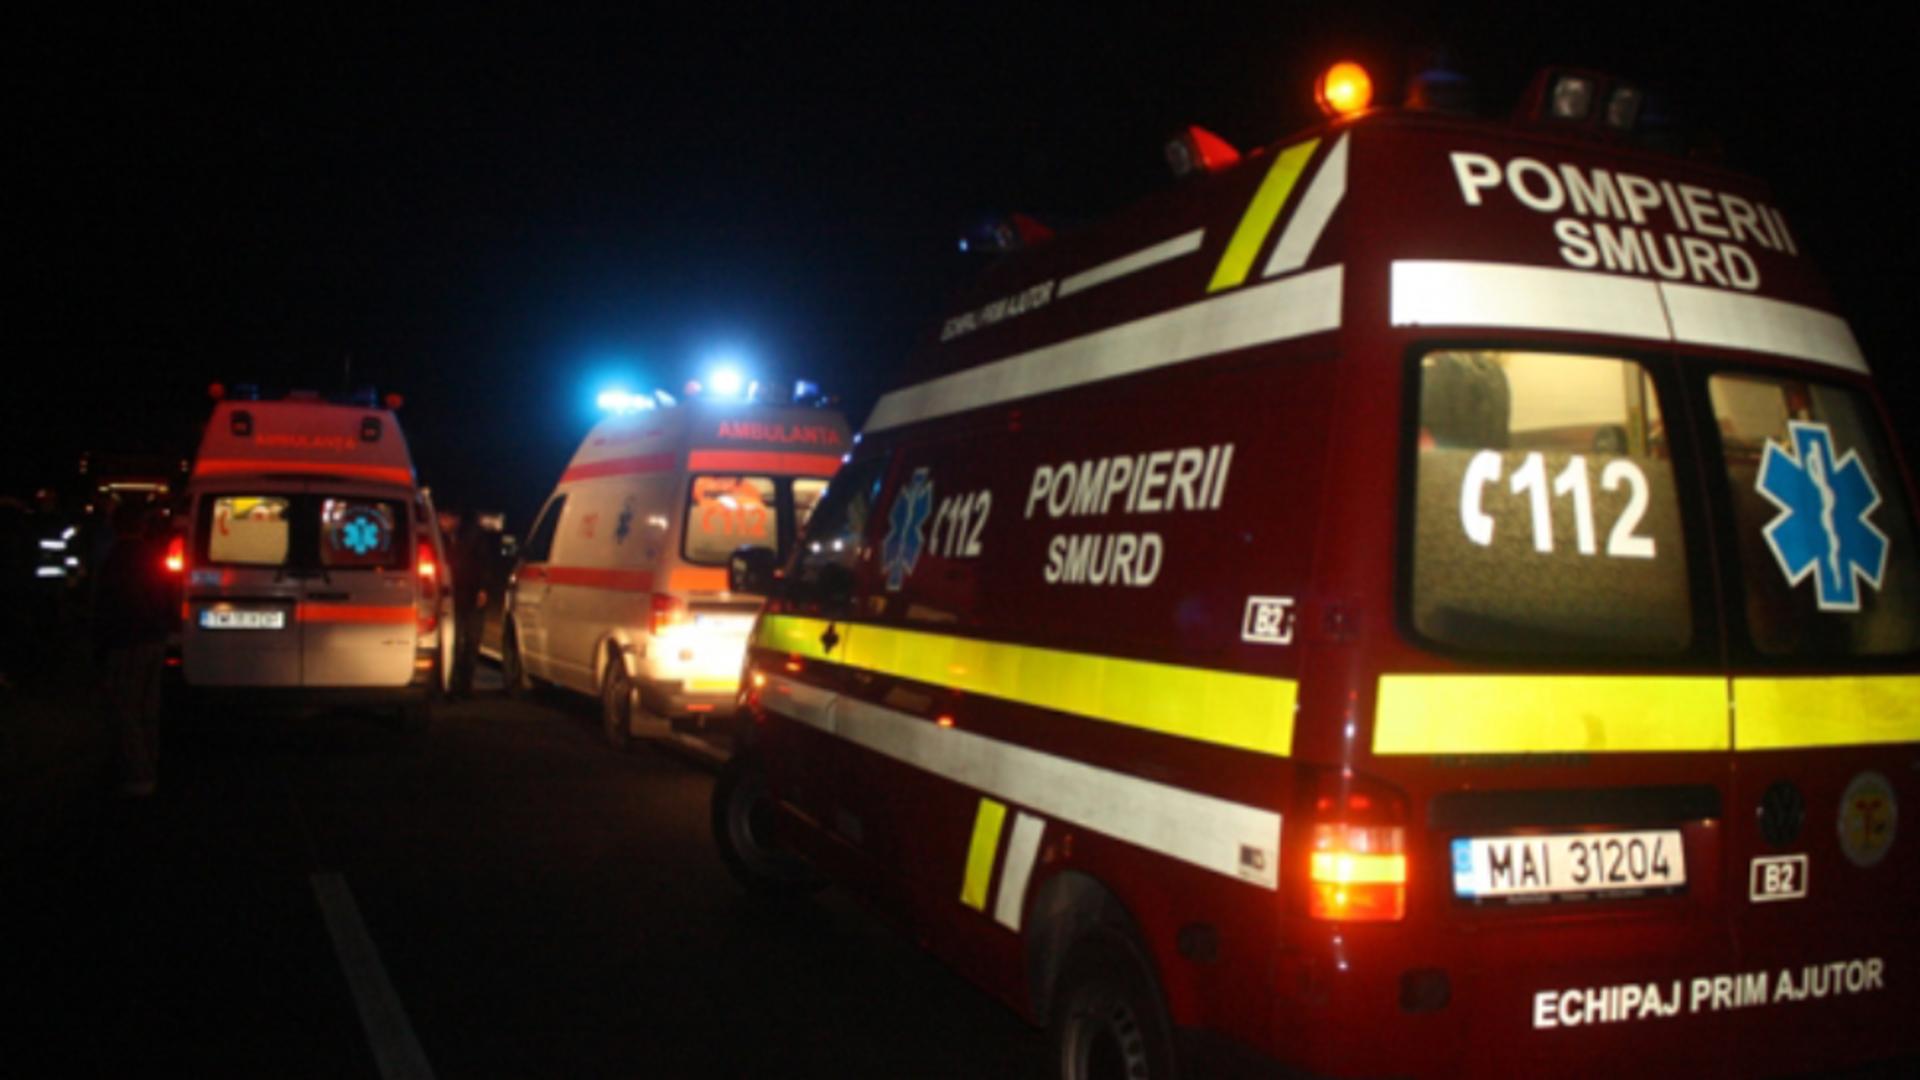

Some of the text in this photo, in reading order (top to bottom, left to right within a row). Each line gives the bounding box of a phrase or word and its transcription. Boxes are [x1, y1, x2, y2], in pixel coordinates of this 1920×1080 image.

[1450, 151, 1798, 256] POMPIERII
[1554, 218, 1761, 290] SMURD
[1025, 444, 1235, 519] POMPIERII
[1509, 451, 1657, 558] 112
[942, 489, 991, 558] 112
[1044, 533, 1163, 586] SMURD
[1487, 838, 1672, 889] MAI 31204
[1765, 863, 1795, 893] B2
[1533, 957, 1885, 1029] ECHIPAJ PRIM AJUTOR
